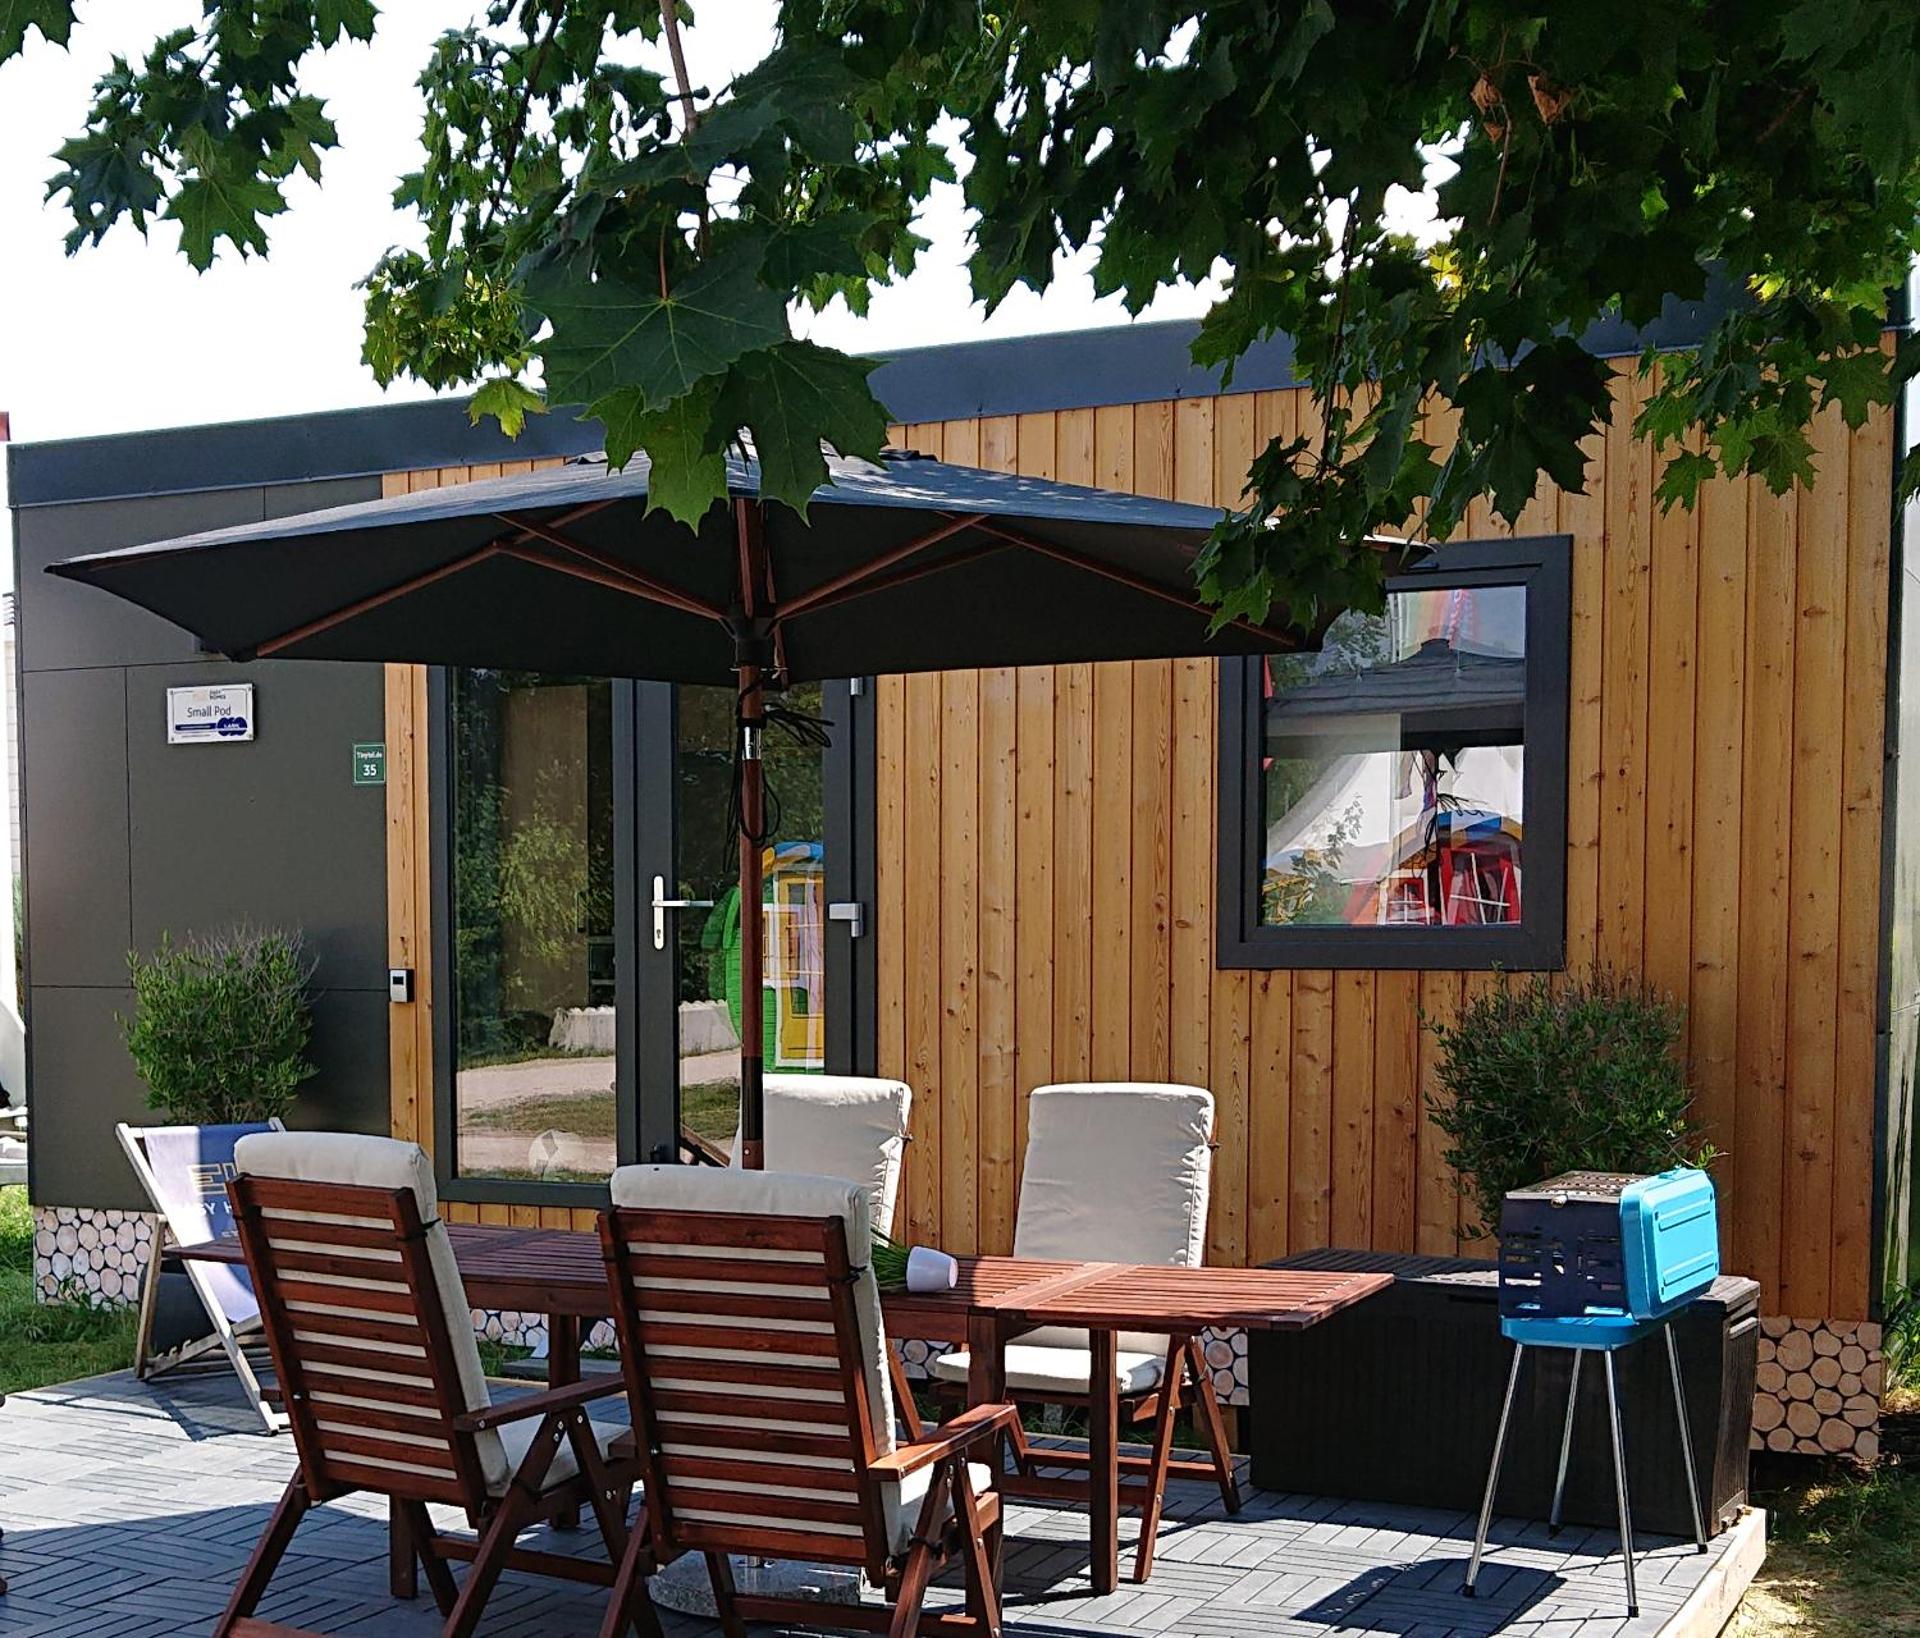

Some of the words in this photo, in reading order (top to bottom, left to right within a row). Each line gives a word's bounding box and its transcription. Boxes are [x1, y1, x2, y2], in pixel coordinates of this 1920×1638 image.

[187, 706, 212, 718] Small
[214, 705, 231, 716] Pod
[363, 764, 377, 776] 35
